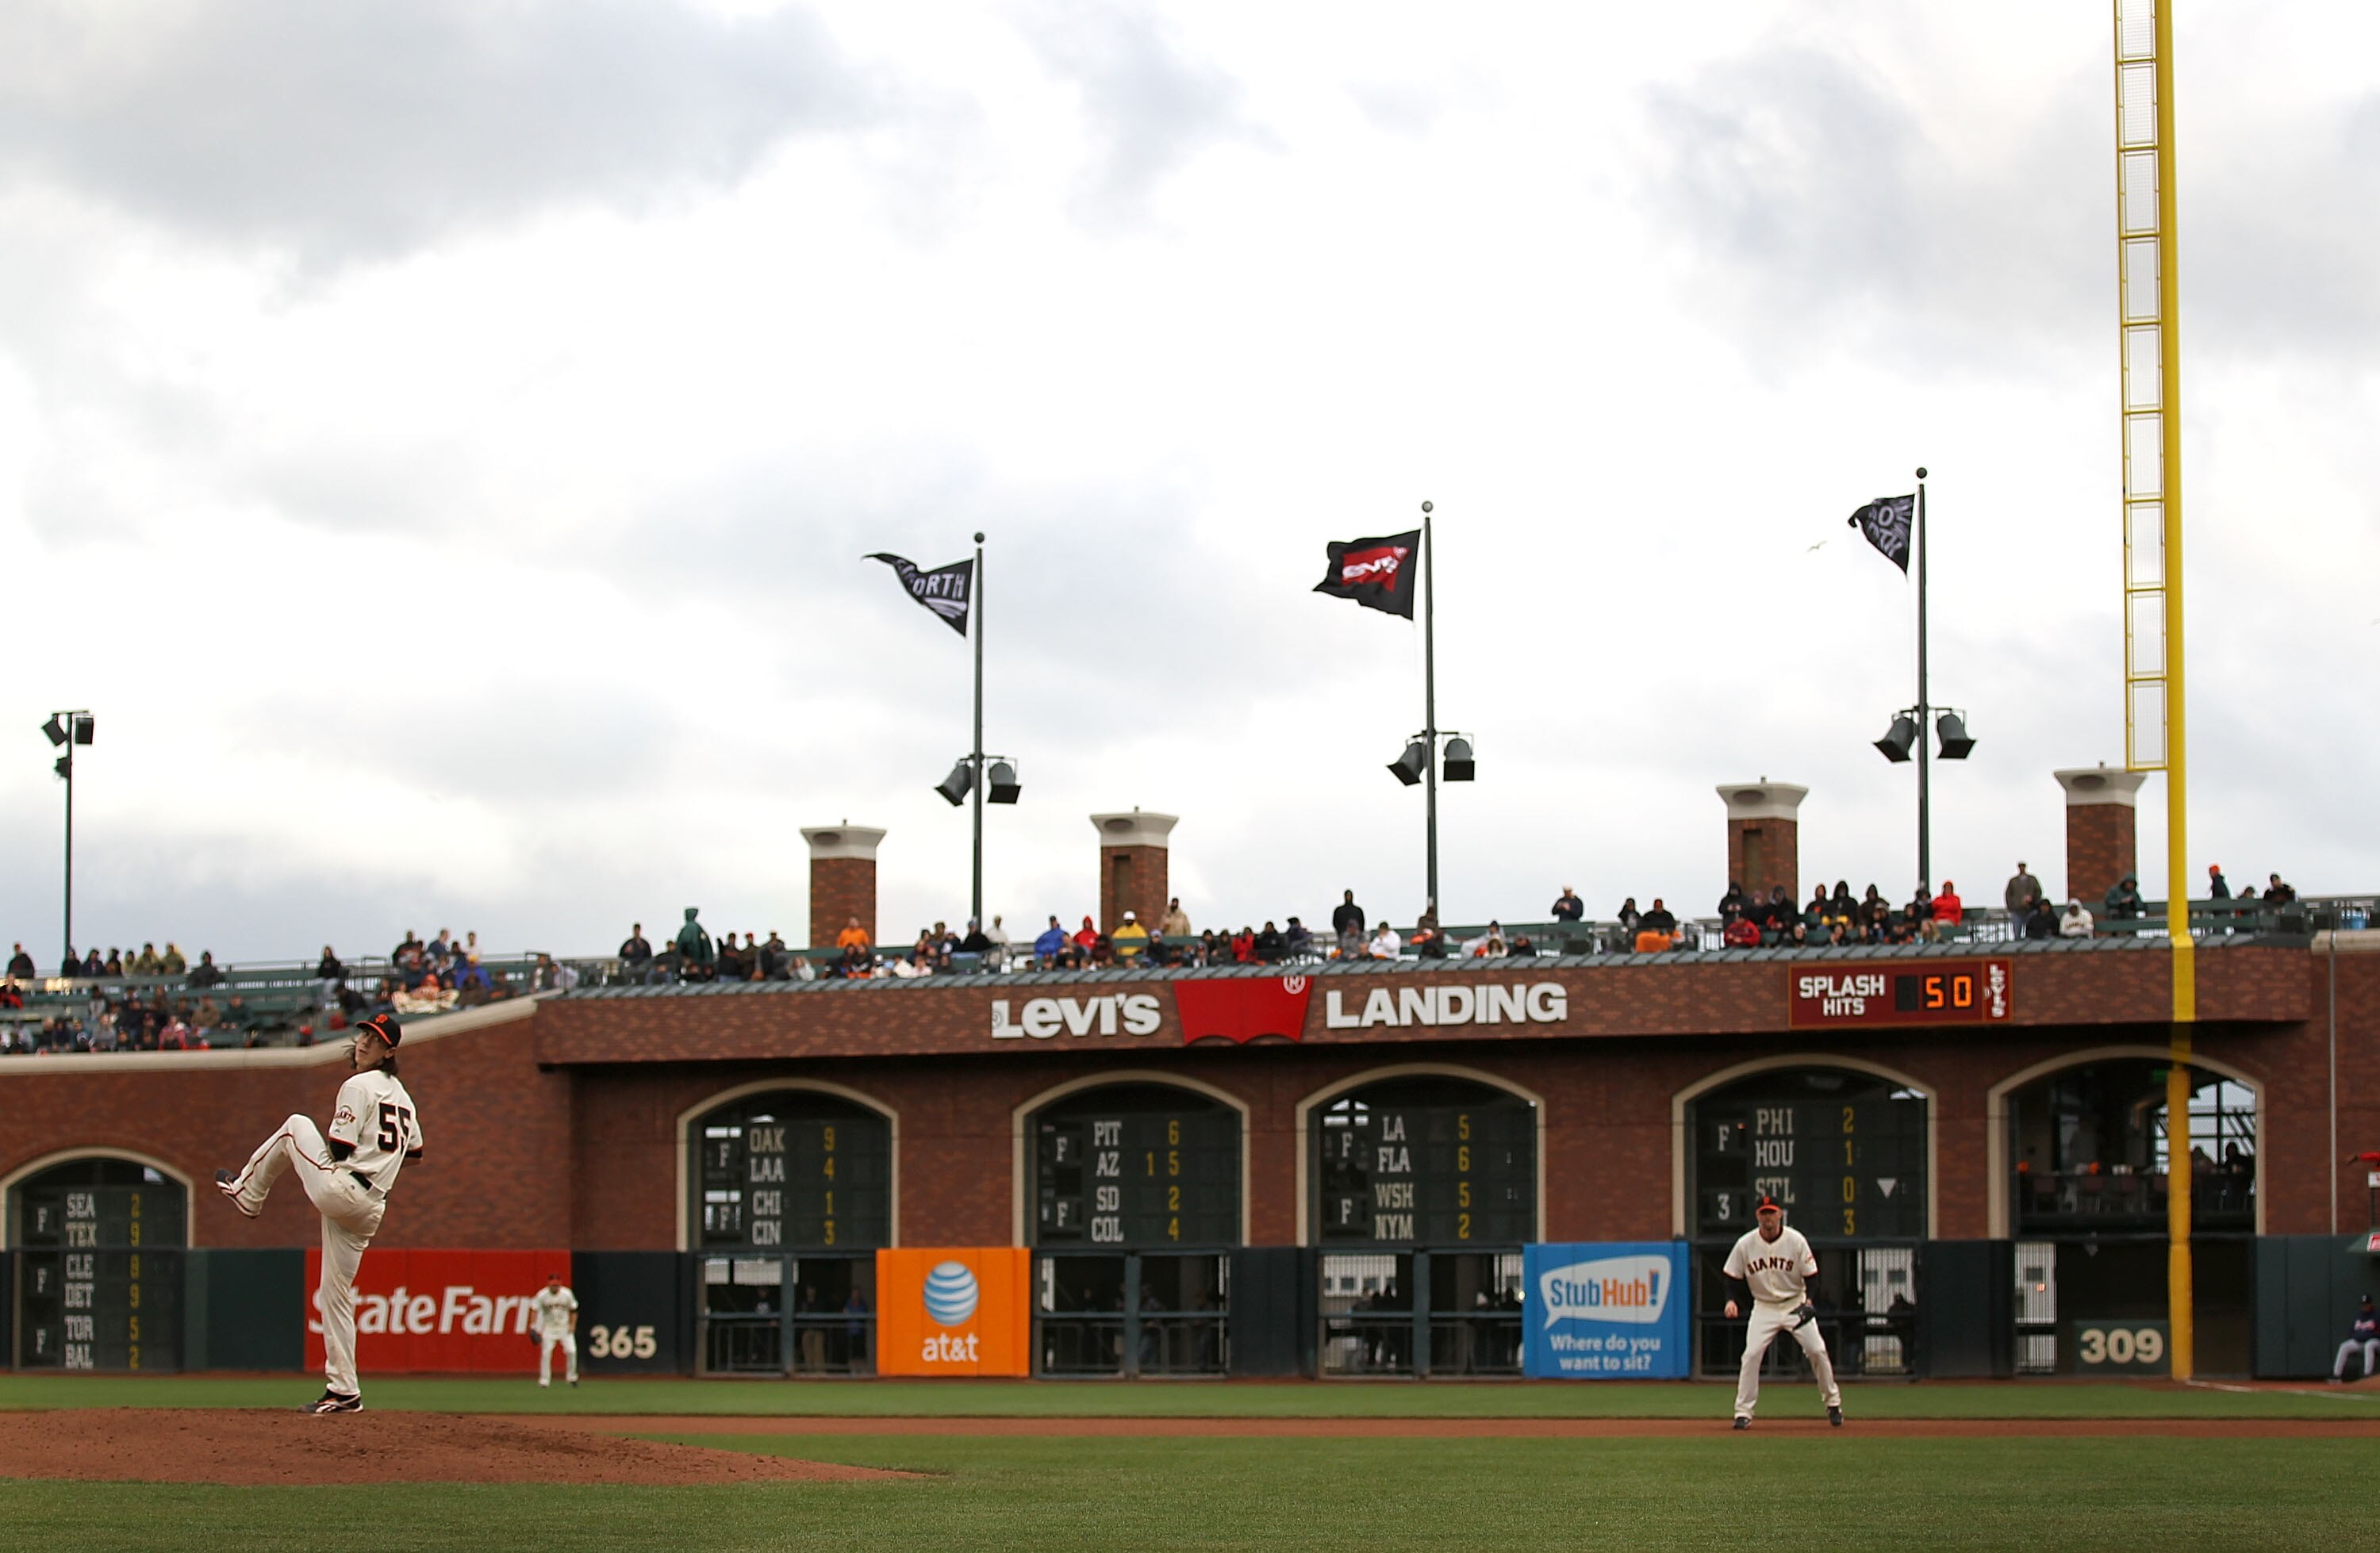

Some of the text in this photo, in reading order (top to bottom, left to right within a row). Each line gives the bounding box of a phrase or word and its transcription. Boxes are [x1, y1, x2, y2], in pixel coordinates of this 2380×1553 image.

[1799, 974, 1971, 1008] SPLASH 50
[1326, 982, 1568, 1029] LANDING
[1823, 998, 1865, 1016] HITS
[378, 1102, 411, 1152] 55
[1094, 1121, 1179, 1146] PIT 6
[1383, 1114, 1469, 1141] LA 5
[1756, 1107, 1854, 1135] PHI 2
[750, 1127, 785, 1152] OAK
[1056, 1137, 1068, 1161] F
[1342, 1133, 1353, 1157] F
[1718, 1125, 1729, 1150] F
[720, 1143, 730, 1168] F
[1096, 1152, 1119, 1176] AZ
[1377, 1147, 1469, 1172] FLA 6
[1755, 1141, 1853, 1167] HOU 1
[750, 1157, 835, 1182] LAA 4
[1096, 1186, 1180, 1211] SD 2
[1375, 1183, 1469, 1208] WSH 5
[1755, 1176, 1855, 1203] STL 0
[66, 1193, 140, 1218] SEA 2
[754, 1191, 834, 1215] CHI 1
[1057, 1202, 1068, 1227] F
[1341, 1199, 1352, 1224] F
[1718, 1194, 1730, 1220] 3
[37, 1207, 48, 1233] F
[720, 1206, 730, 1230] F
[1092, 1217, 1179, 1242] COL 4
[1375, 1214, 1469, 1240] NYM 2
[1844, 1209, 1855, 1235] 3
[65, 1221, 140, 1247] TEX 9
[752, 1220, 835, 1245] CIN 3
[66, 1254, 94, 1279] CLE
[37, 1268, 47, 1293] F
[1551, 1271, 1659, 1306] StubHub!
[64, 1283, 94, 1308] DET
[64, 1315, 139, 1340] TOR 5
[36, 1329, 46, 1354] F
[589, 1324, 657, 1359] 365
[921, 1332, 980, 1363] at&t
[1550, 1335, 1660, 1356] Where do you
[2080, 1328, 2163, 1363] 309
[64, 1344, 139, 1370] BAL 2
[1560, 1353, 1652, 1371] want to sit?
